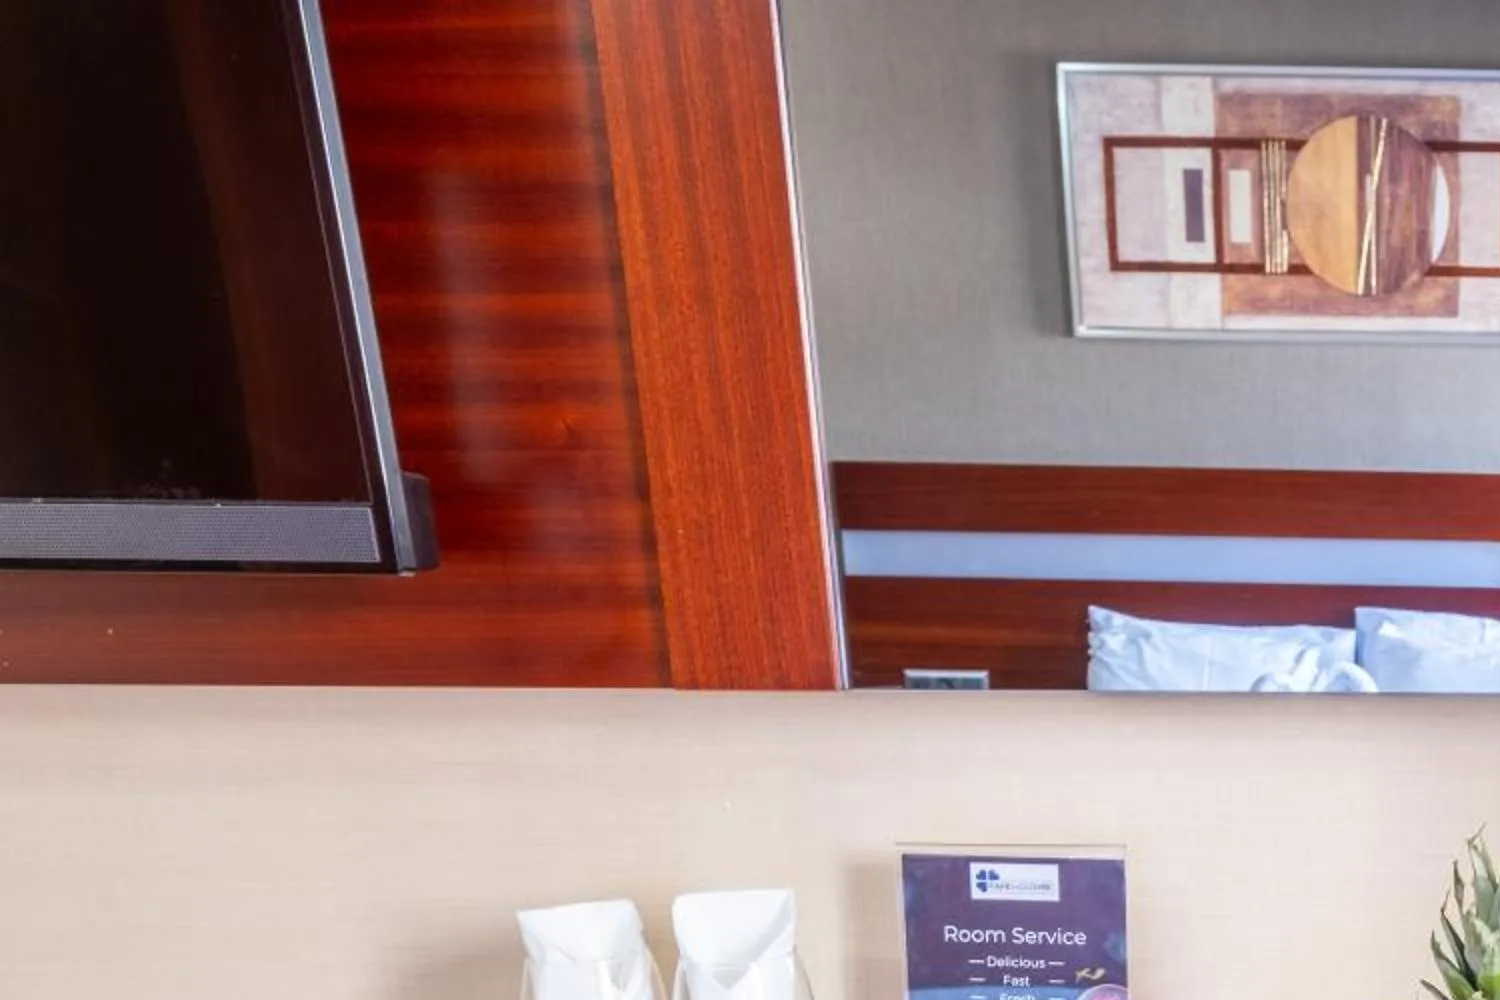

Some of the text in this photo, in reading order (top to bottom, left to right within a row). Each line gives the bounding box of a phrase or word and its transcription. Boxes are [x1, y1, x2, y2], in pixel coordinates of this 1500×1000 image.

[943, 925, 1087, 946] Room Service
[987, 956, 1046, 969] Delicious
[1003, 975, 1031, 988] Fast
